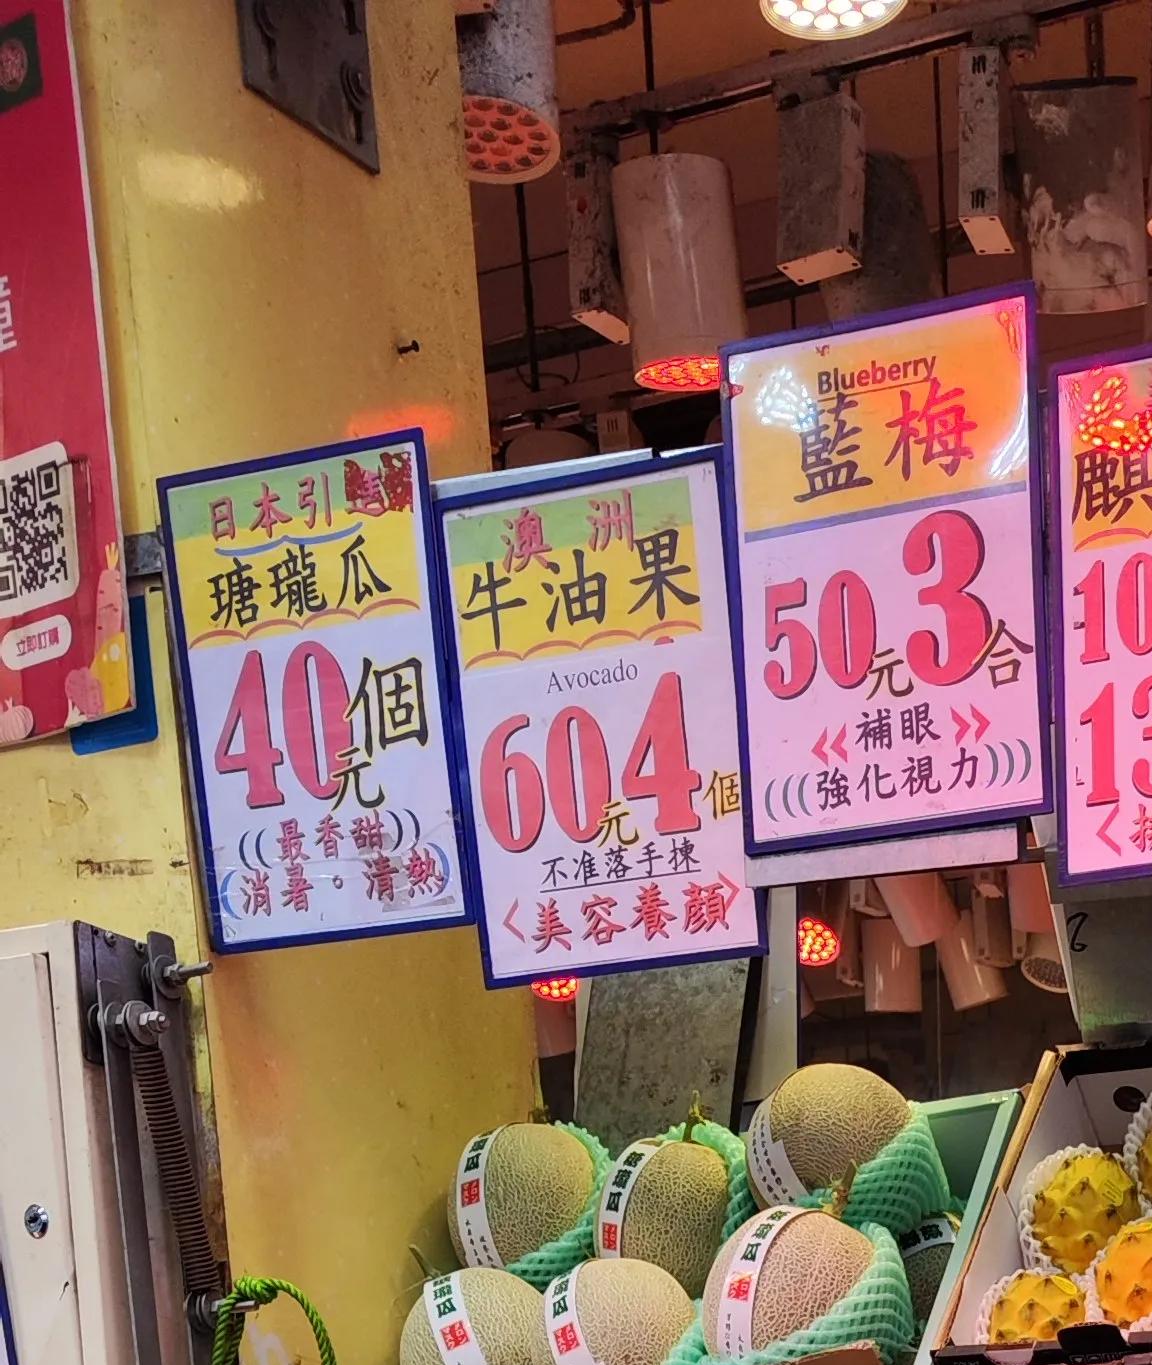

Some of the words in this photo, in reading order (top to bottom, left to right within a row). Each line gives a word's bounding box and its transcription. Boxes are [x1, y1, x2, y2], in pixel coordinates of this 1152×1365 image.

[816, 353, 938, 397] Blueberry
[793, 377, 979, 504] 藍梅
[500, 488, 638, 575] 澳洲
[460, 528, 701, 652] 牛油果
[546, 657, 639, 695] Avocado
